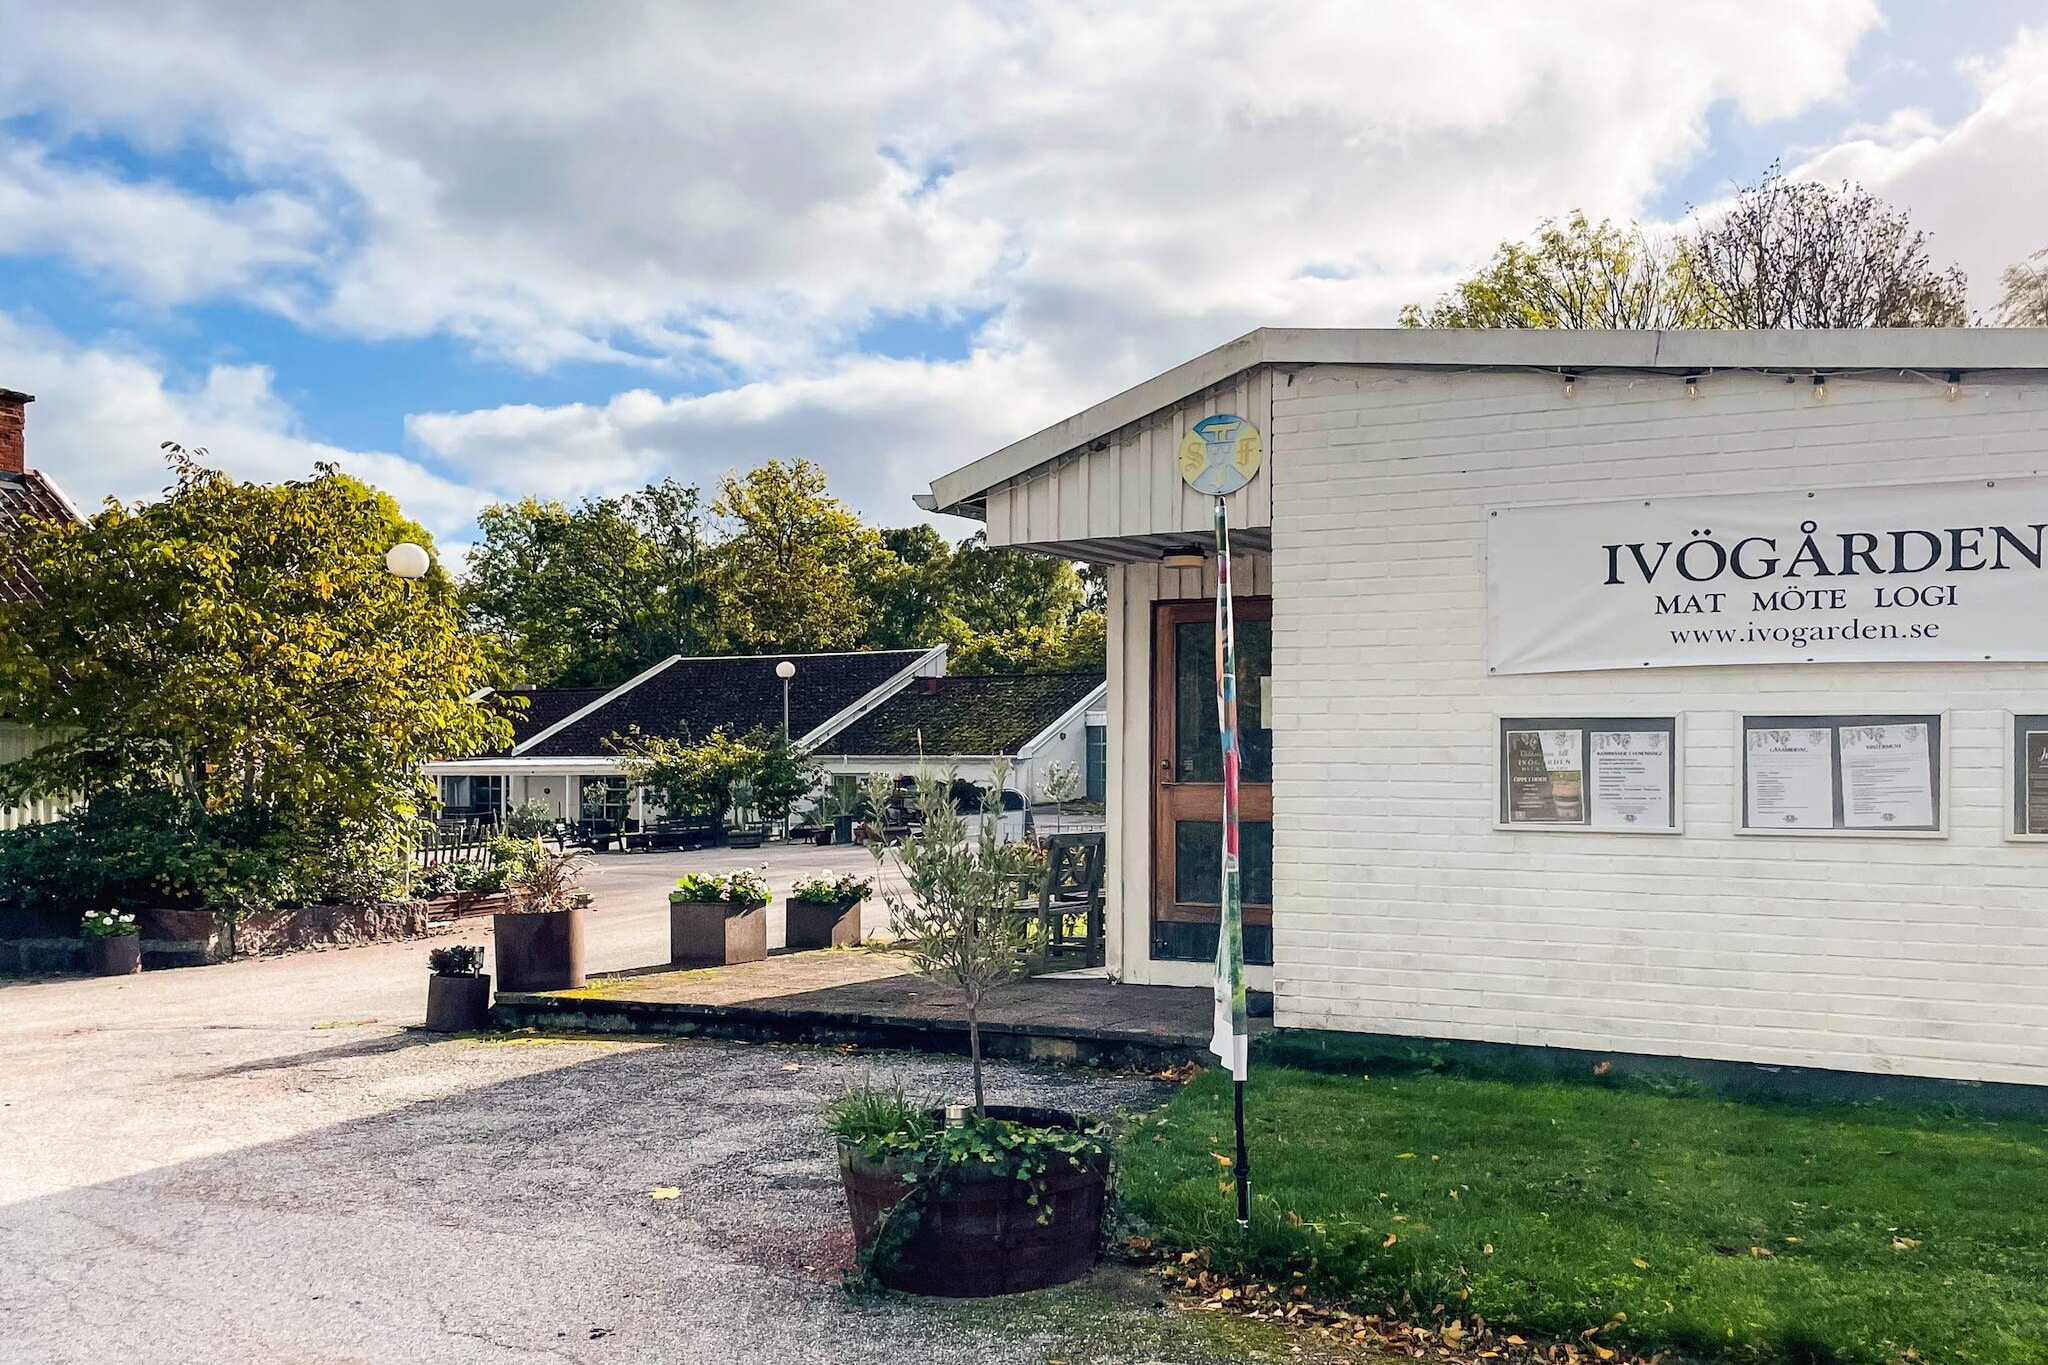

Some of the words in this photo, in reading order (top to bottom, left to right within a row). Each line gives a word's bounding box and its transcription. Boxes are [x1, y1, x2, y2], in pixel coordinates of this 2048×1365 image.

[1601, 518, 2048, 585] IVÖGÅRDEN
[1654, 593, 1726, 615] MAT
[1751, 585, 1847, 612] MÖTE
[1874, 585, 1958, 608] LOGI
[1670, 617, 1941, 649] www.ivogarden.se
